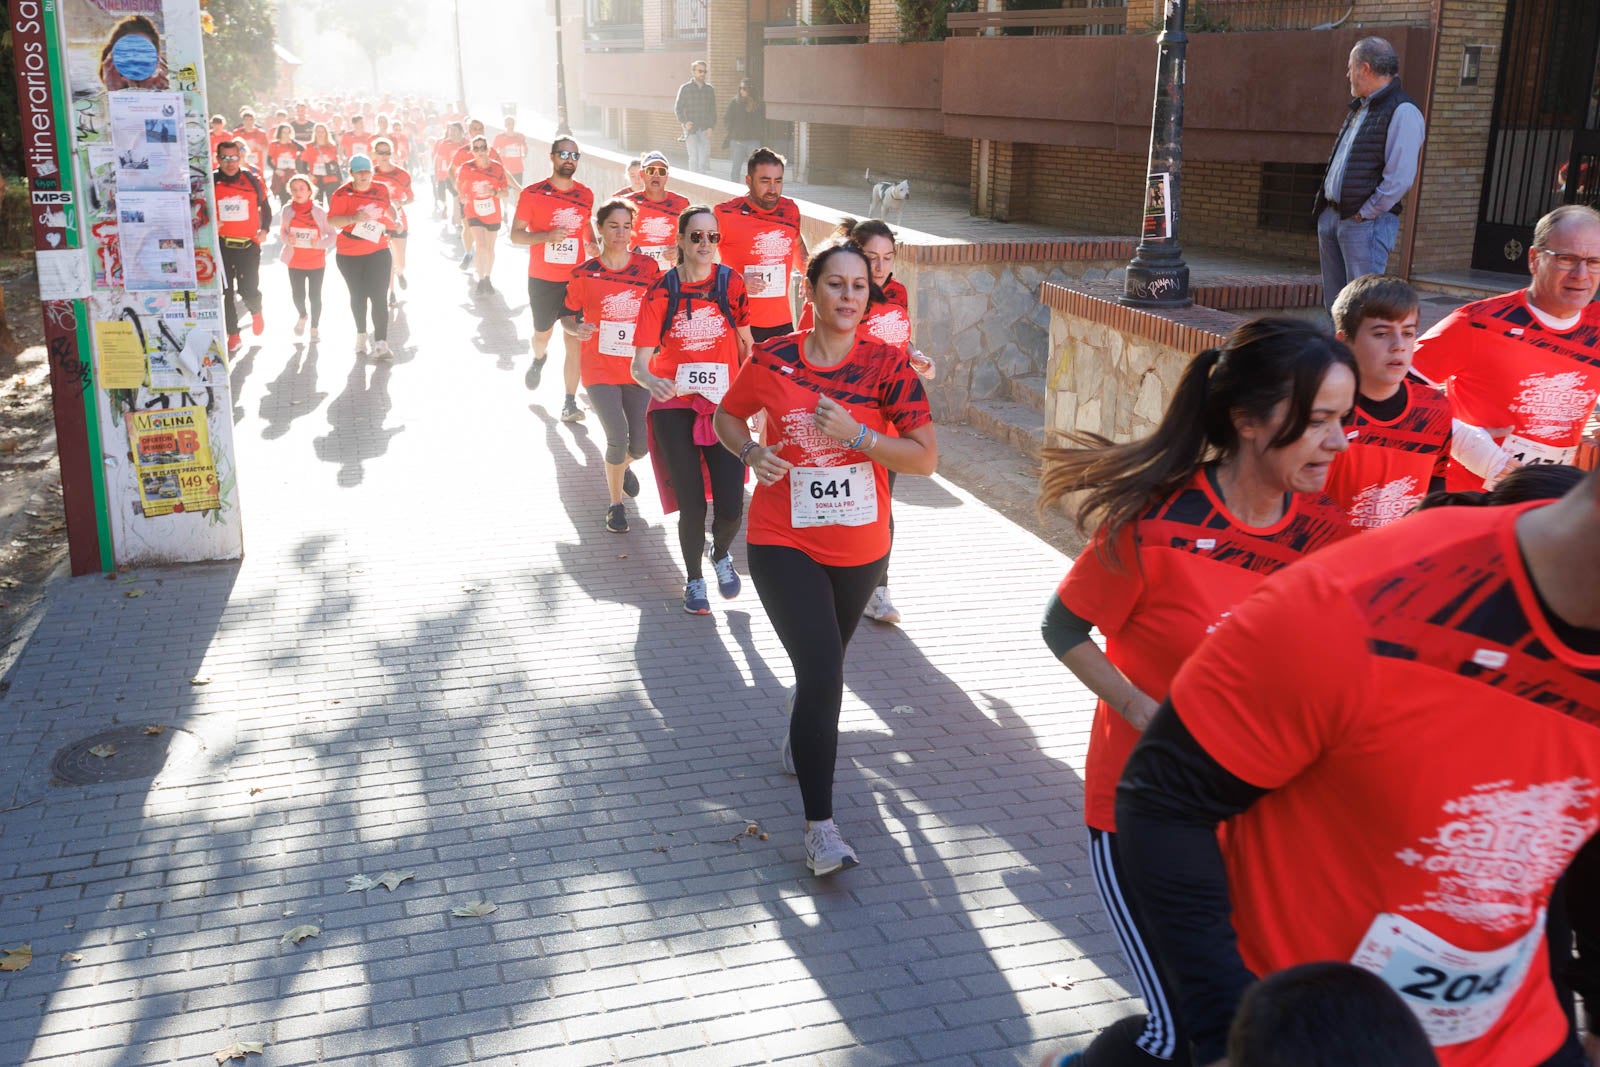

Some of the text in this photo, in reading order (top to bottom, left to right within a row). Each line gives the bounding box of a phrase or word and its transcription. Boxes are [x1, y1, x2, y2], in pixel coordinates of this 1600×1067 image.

[34, 193, 71, 202] MPS
[551, 243, 573, 252] 1254
[675, 318, 722, 329] carrera
[618, 330, 626, 340] 9
[688, 371, 717, 384] 565
[1520, 389, 1590, 409] carrera
[181, 475, 202, 488] 149
[810, 478, 850, 499] 641
[1400, 964, 1510, 1003] 204
